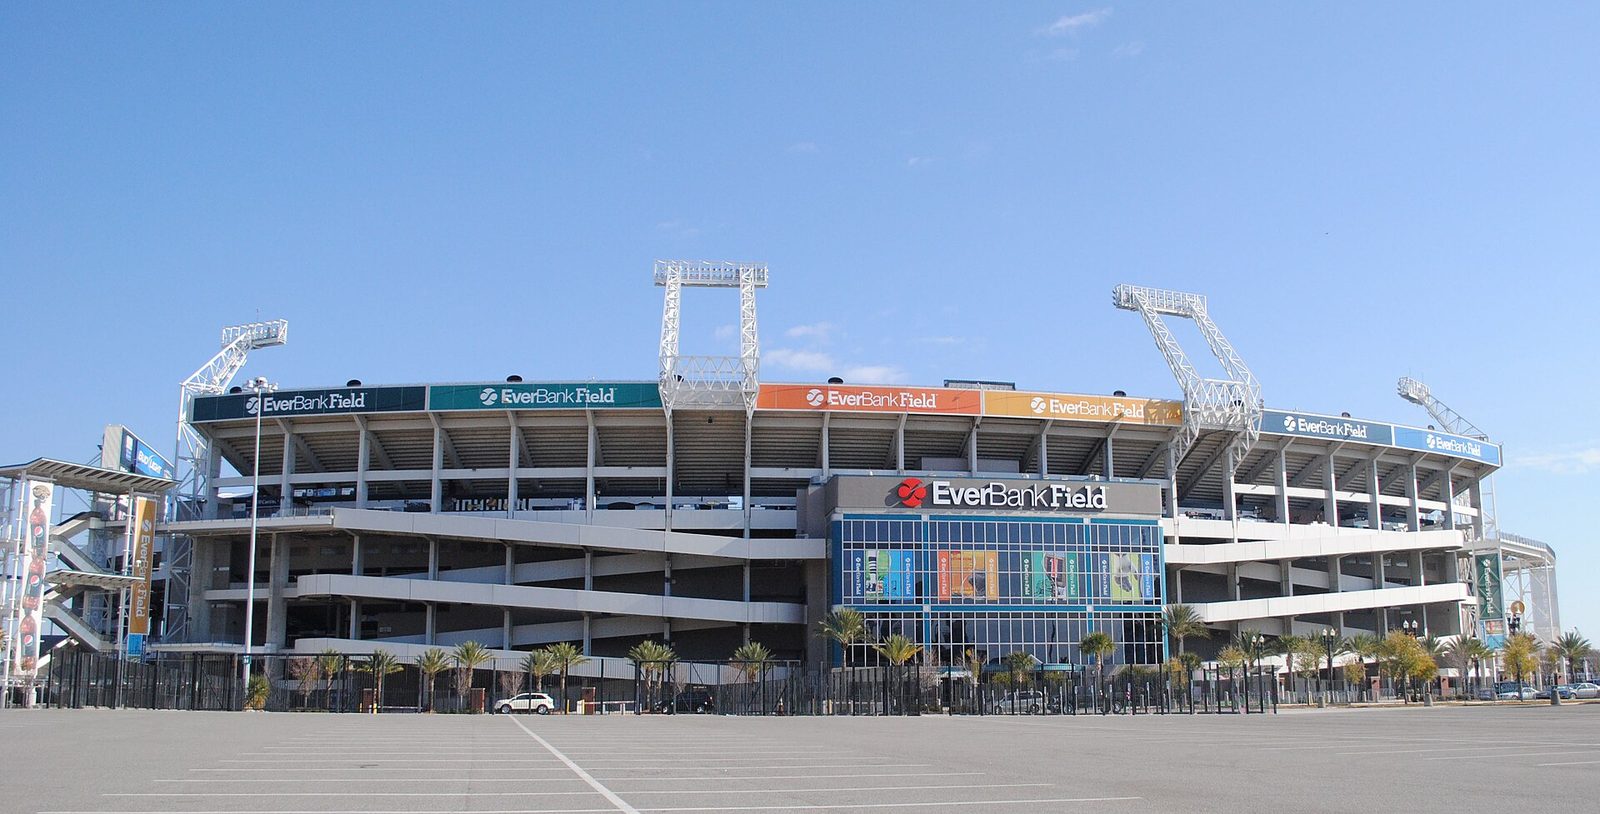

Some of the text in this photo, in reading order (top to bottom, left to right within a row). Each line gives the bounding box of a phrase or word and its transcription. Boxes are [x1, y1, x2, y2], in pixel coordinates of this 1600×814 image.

[263, 392, 365, 412] EverBank Field
[501, 385, 614, 404] EverBank Field
[827, 390, 936, 408] EverBank Field
[1050, 399, 1144, 418] EverBank Field
[1297, 418, 1367, 438] EverBank Field
[1436, 436, 1481, 456] EverBank Field
[932, 480, 1108, 508] EverBank Field
[136, 535, 151, 618] EverBak Field
